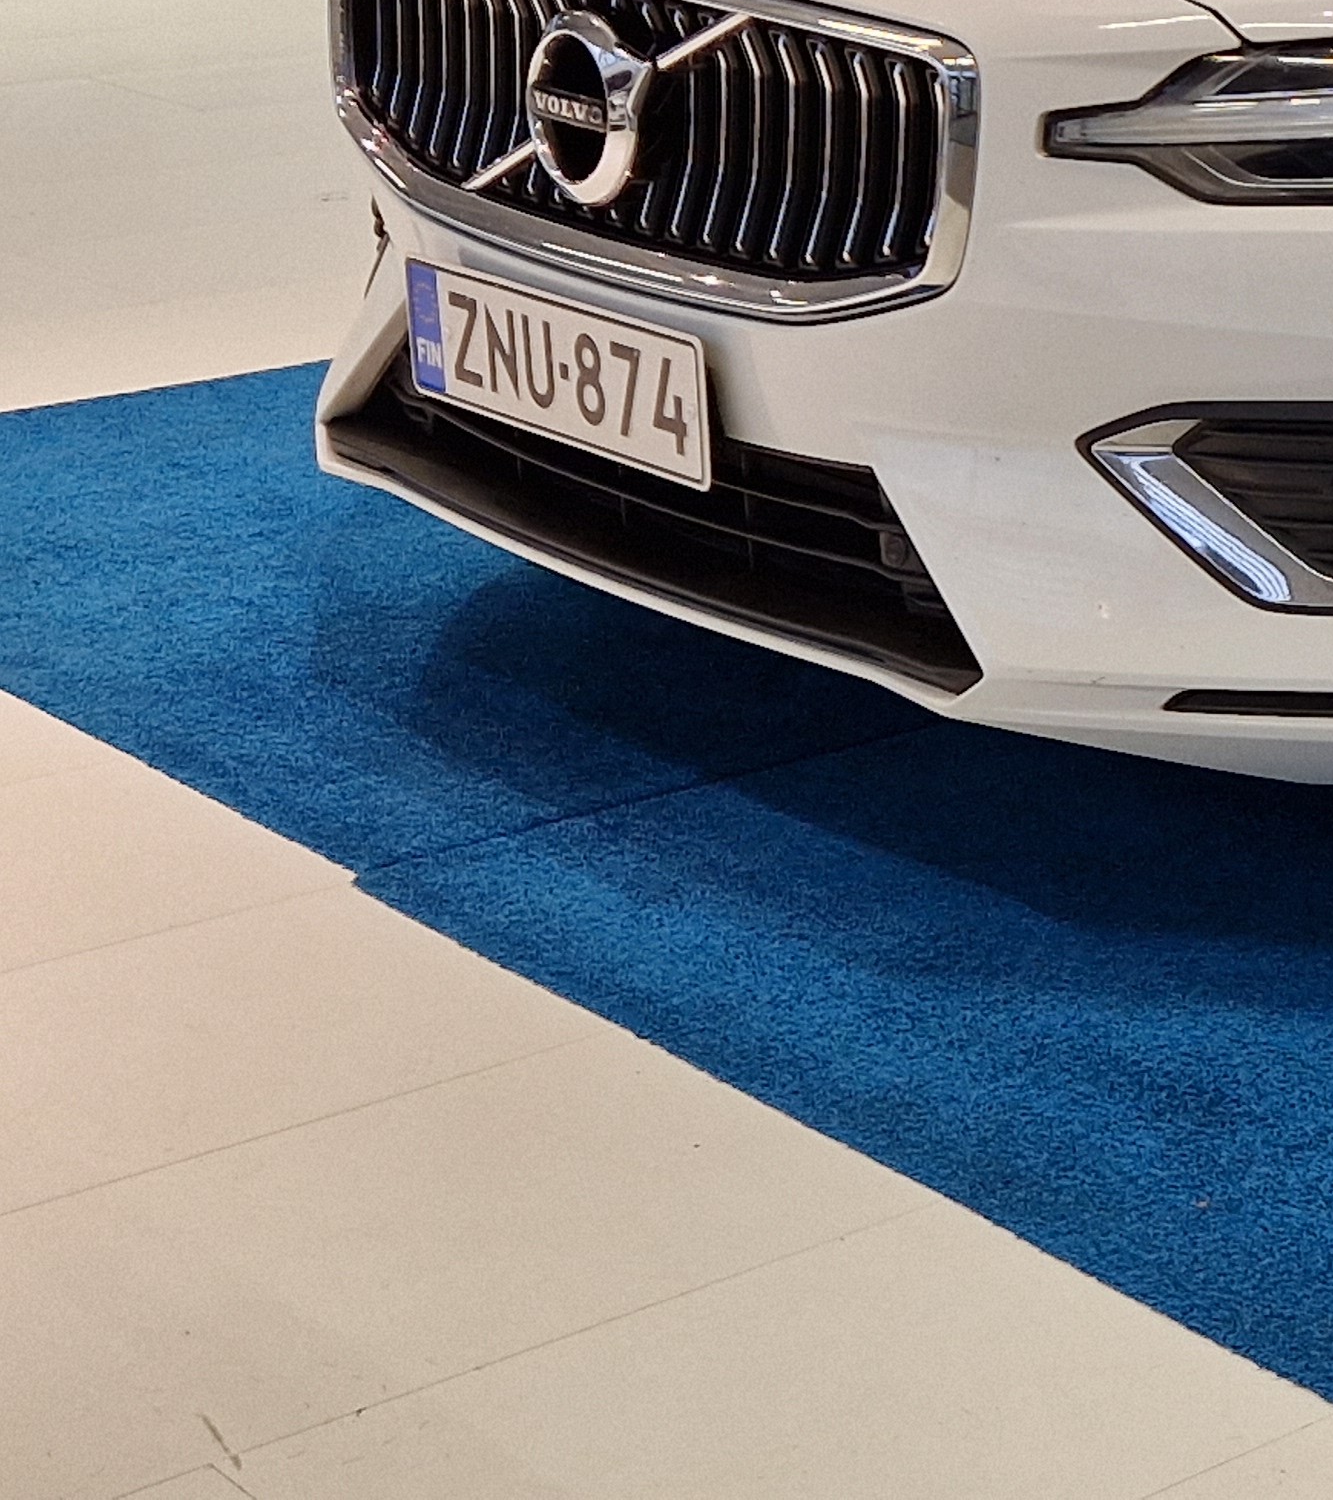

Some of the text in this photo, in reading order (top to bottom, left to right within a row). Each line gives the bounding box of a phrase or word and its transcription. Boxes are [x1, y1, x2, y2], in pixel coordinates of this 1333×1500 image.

[532, 89, 603, 124] VOLVO
[417, 336, 442, 369] FIN
[448, 290, 687, 457] ZNU-874
